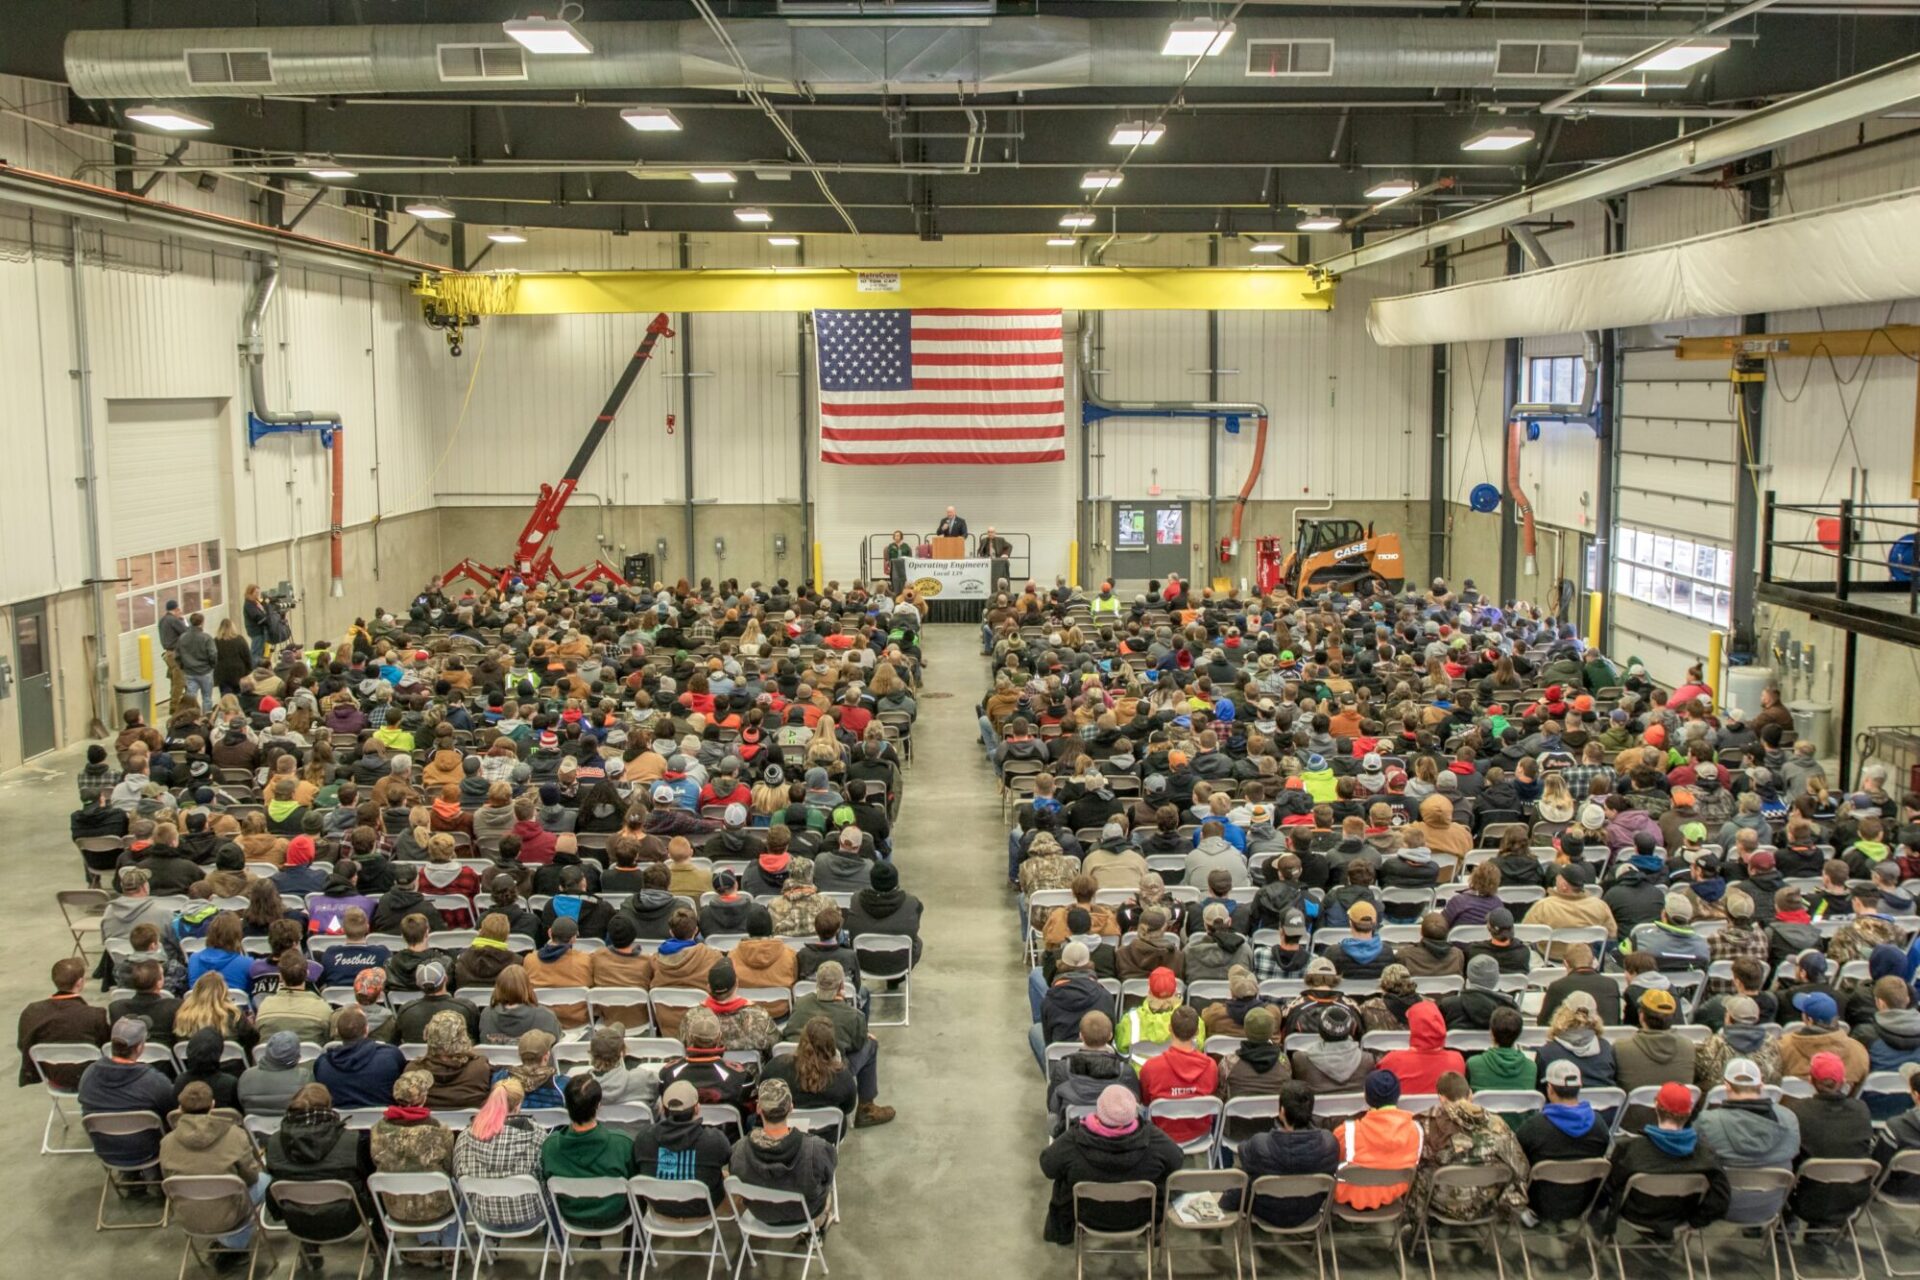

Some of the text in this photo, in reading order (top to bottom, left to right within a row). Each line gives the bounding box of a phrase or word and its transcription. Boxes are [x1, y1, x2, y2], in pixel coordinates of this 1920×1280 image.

[1334, 542, 1368, 559] CASE
[908, 561, 989, 569] Operating Engineers
[334, 952, 377, 966] Football
